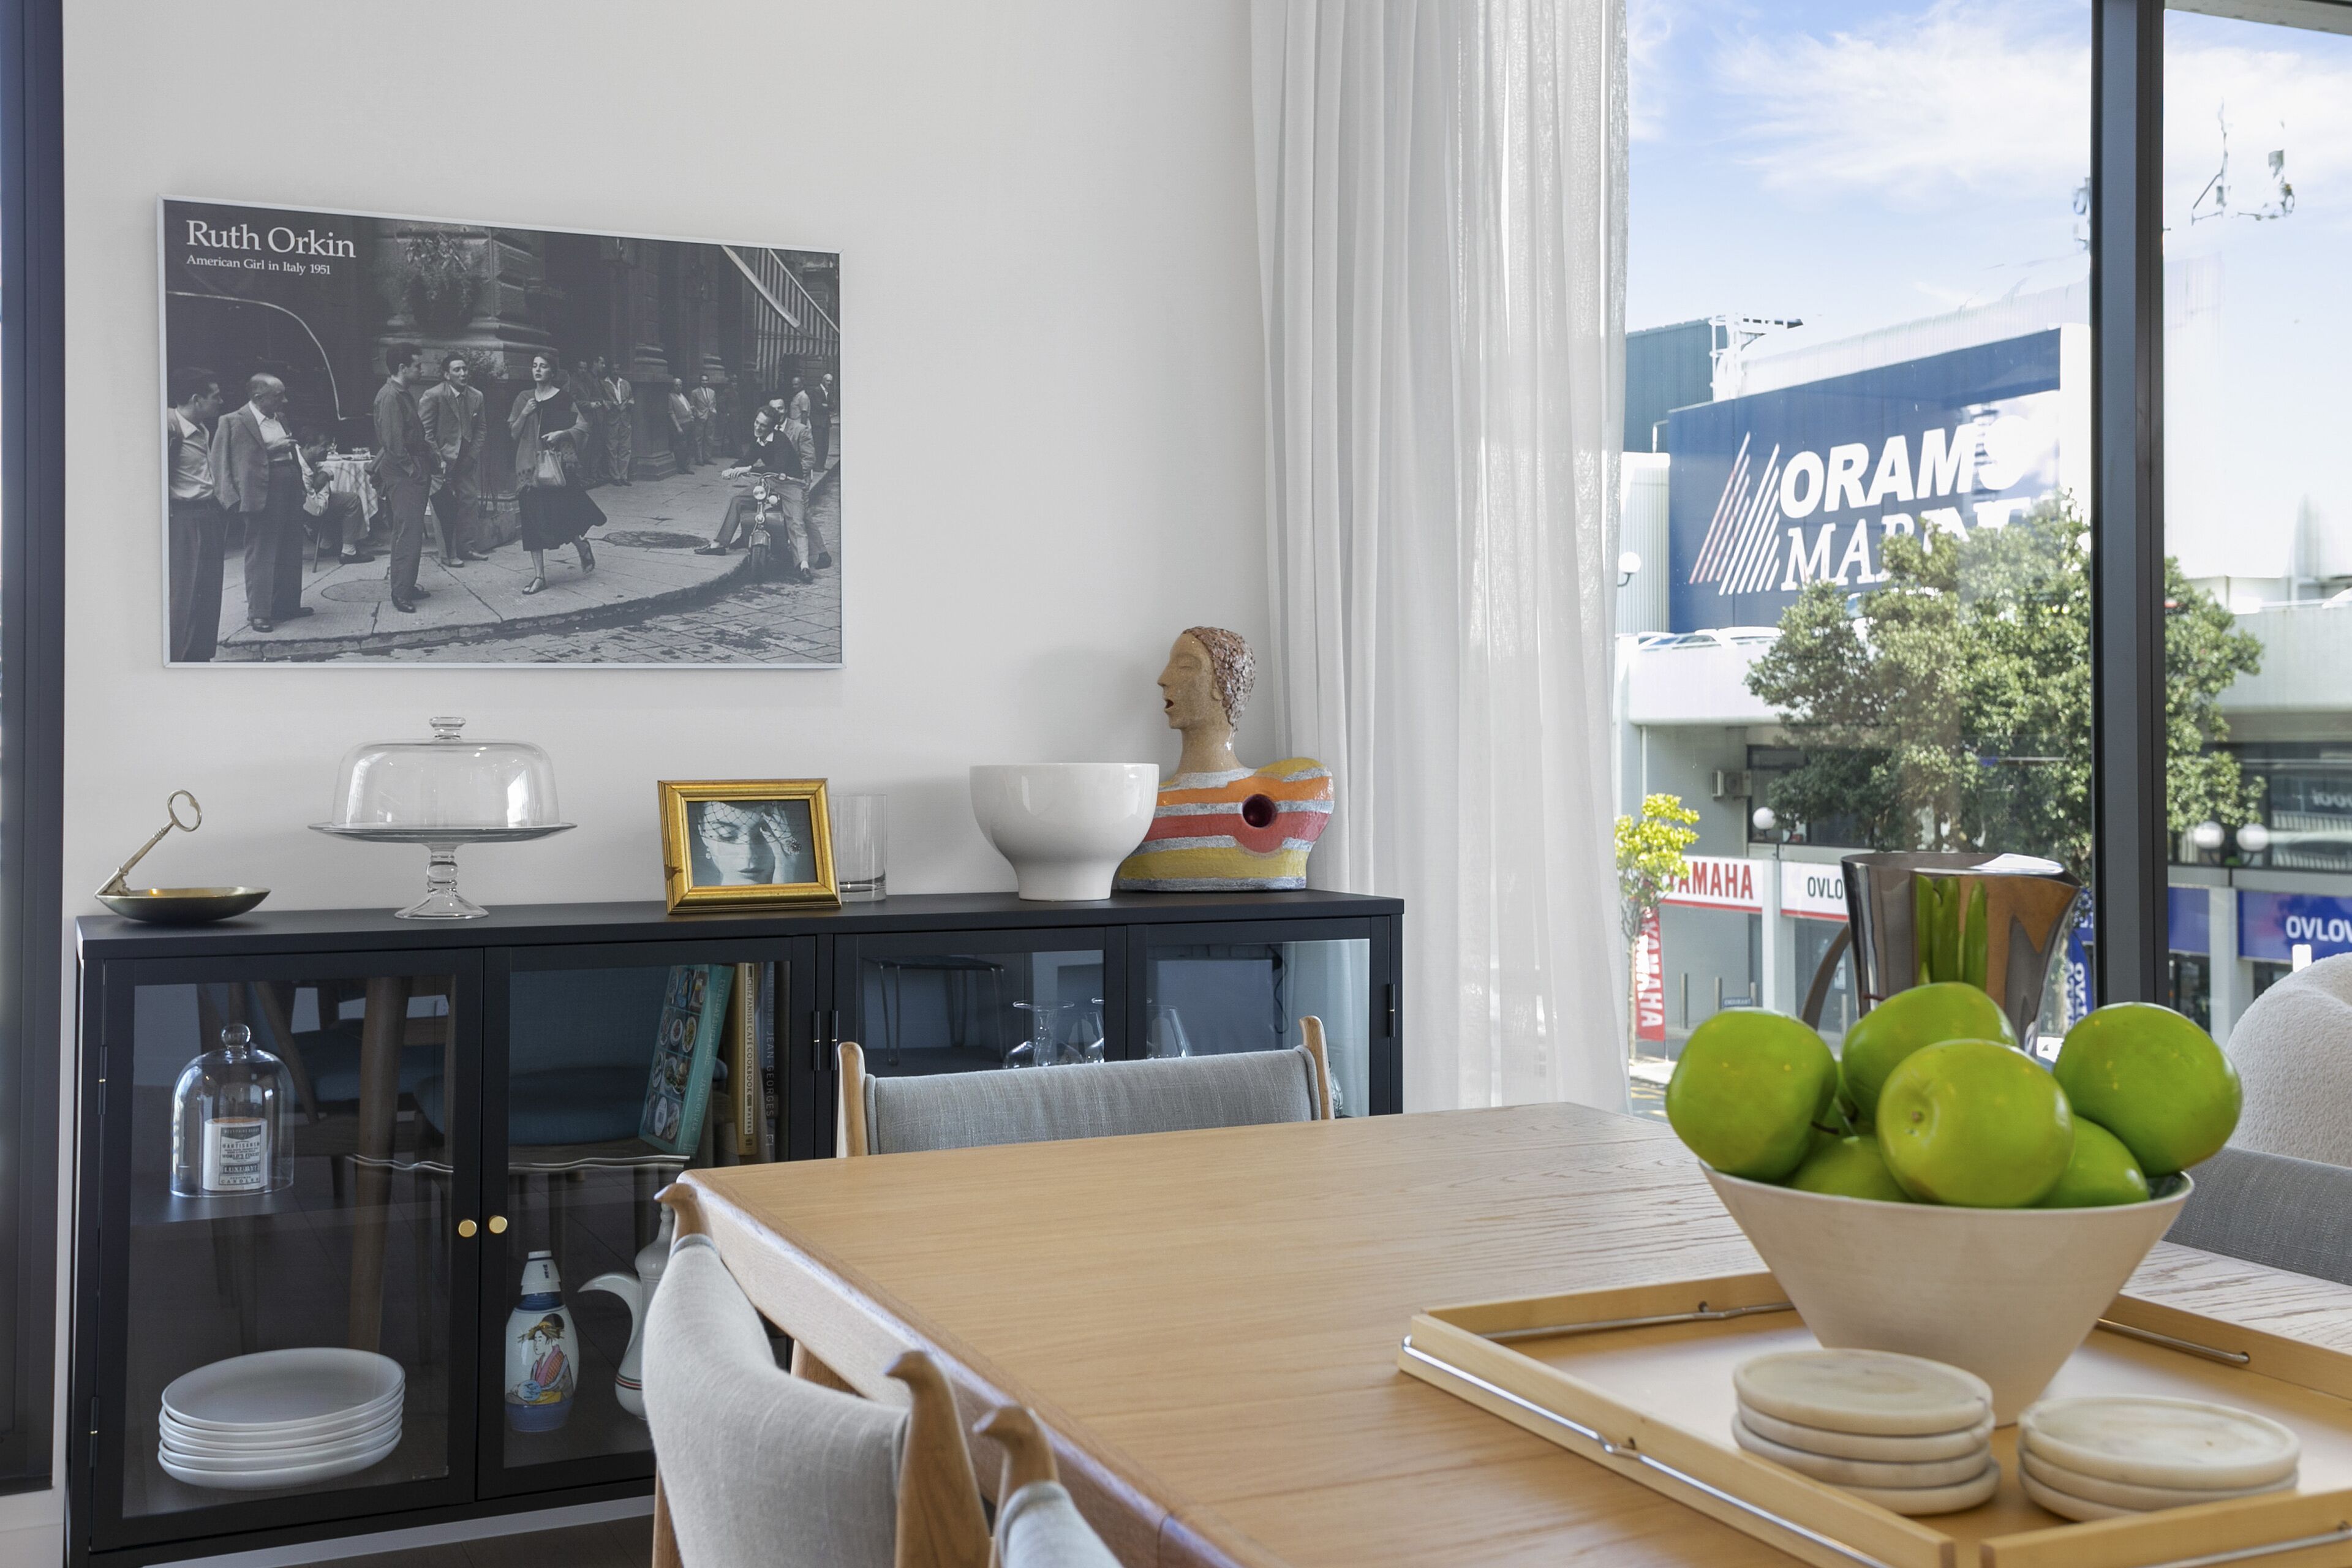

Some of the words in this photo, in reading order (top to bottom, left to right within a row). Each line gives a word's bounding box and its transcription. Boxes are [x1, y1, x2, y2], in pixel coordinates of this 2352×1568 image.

[186, 220, 262, 251] Ruth
[268, 227, 356, 258] Orkin
[186, 255, 241, 268] American
[243, 258, 265, 270] Girl
[268, 262, 279, 271] in
[282, 262, 306, 276] Italy
[309, 264, 331, 274] 1951
[766, 1031, 774, 1117] JEAN-GEORGES
